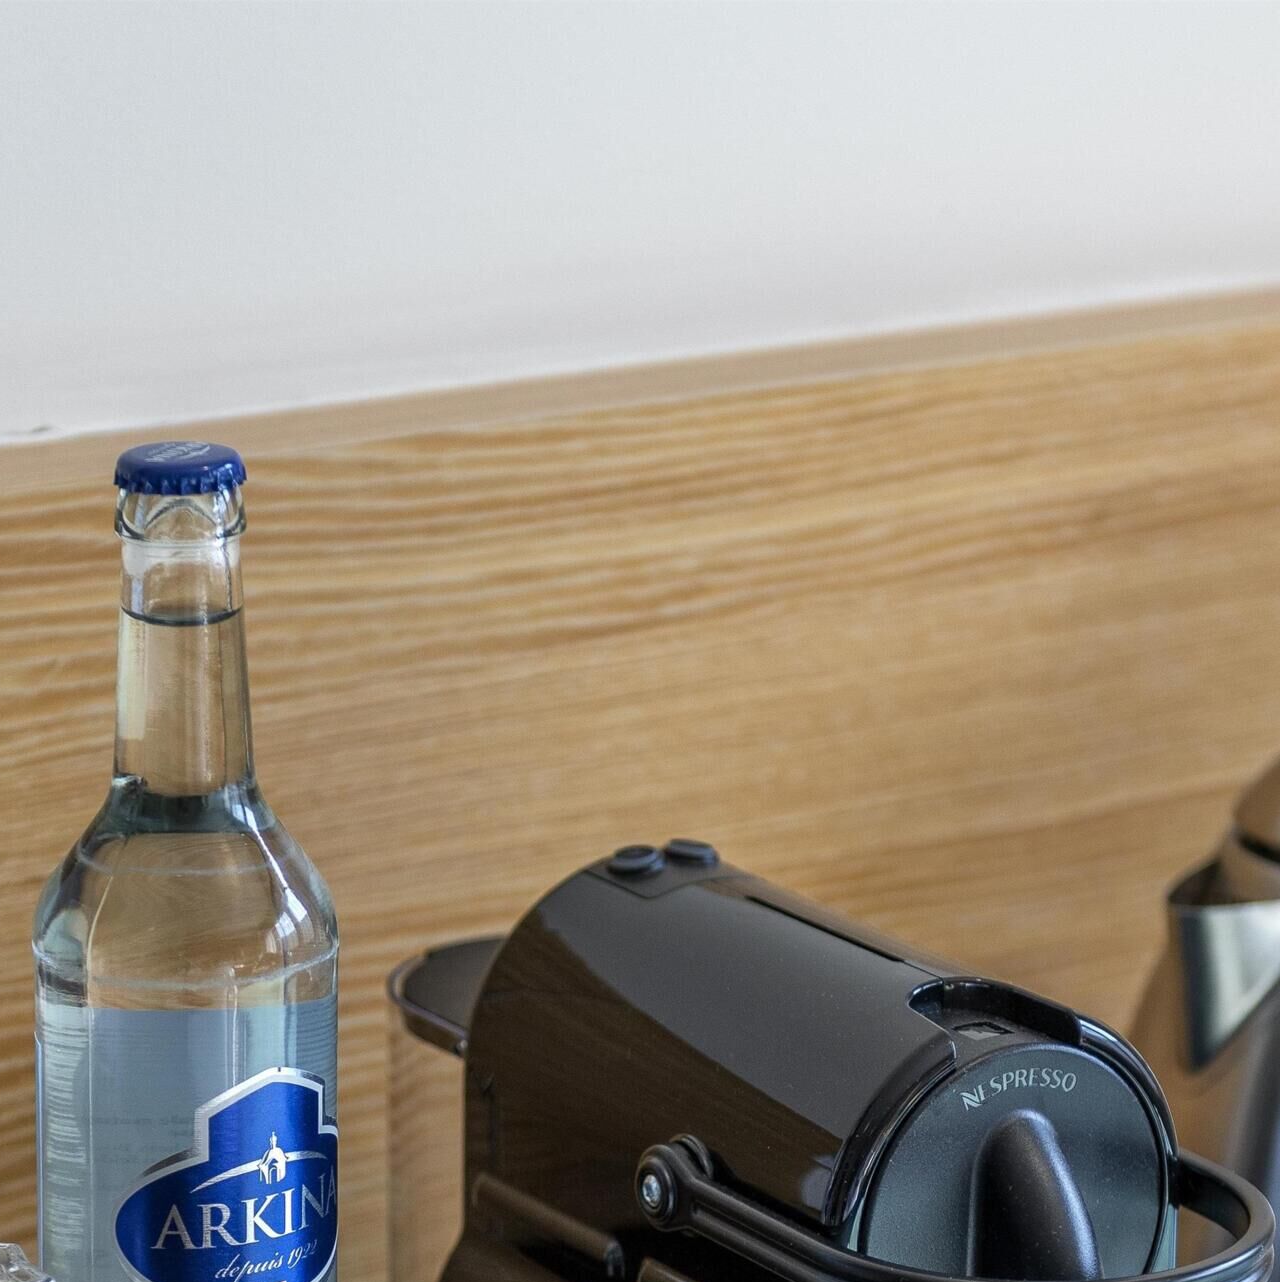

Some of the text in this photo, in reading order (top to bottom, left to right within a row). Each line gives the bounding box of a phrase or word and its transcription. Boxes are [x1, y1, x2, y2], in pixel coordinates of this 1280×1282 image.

[959, 1067, 1078, 1111] NESPRESSO
[150, 1164, 337, 1250] ARKINA
[287, 1238, 318, 1270] 1922
